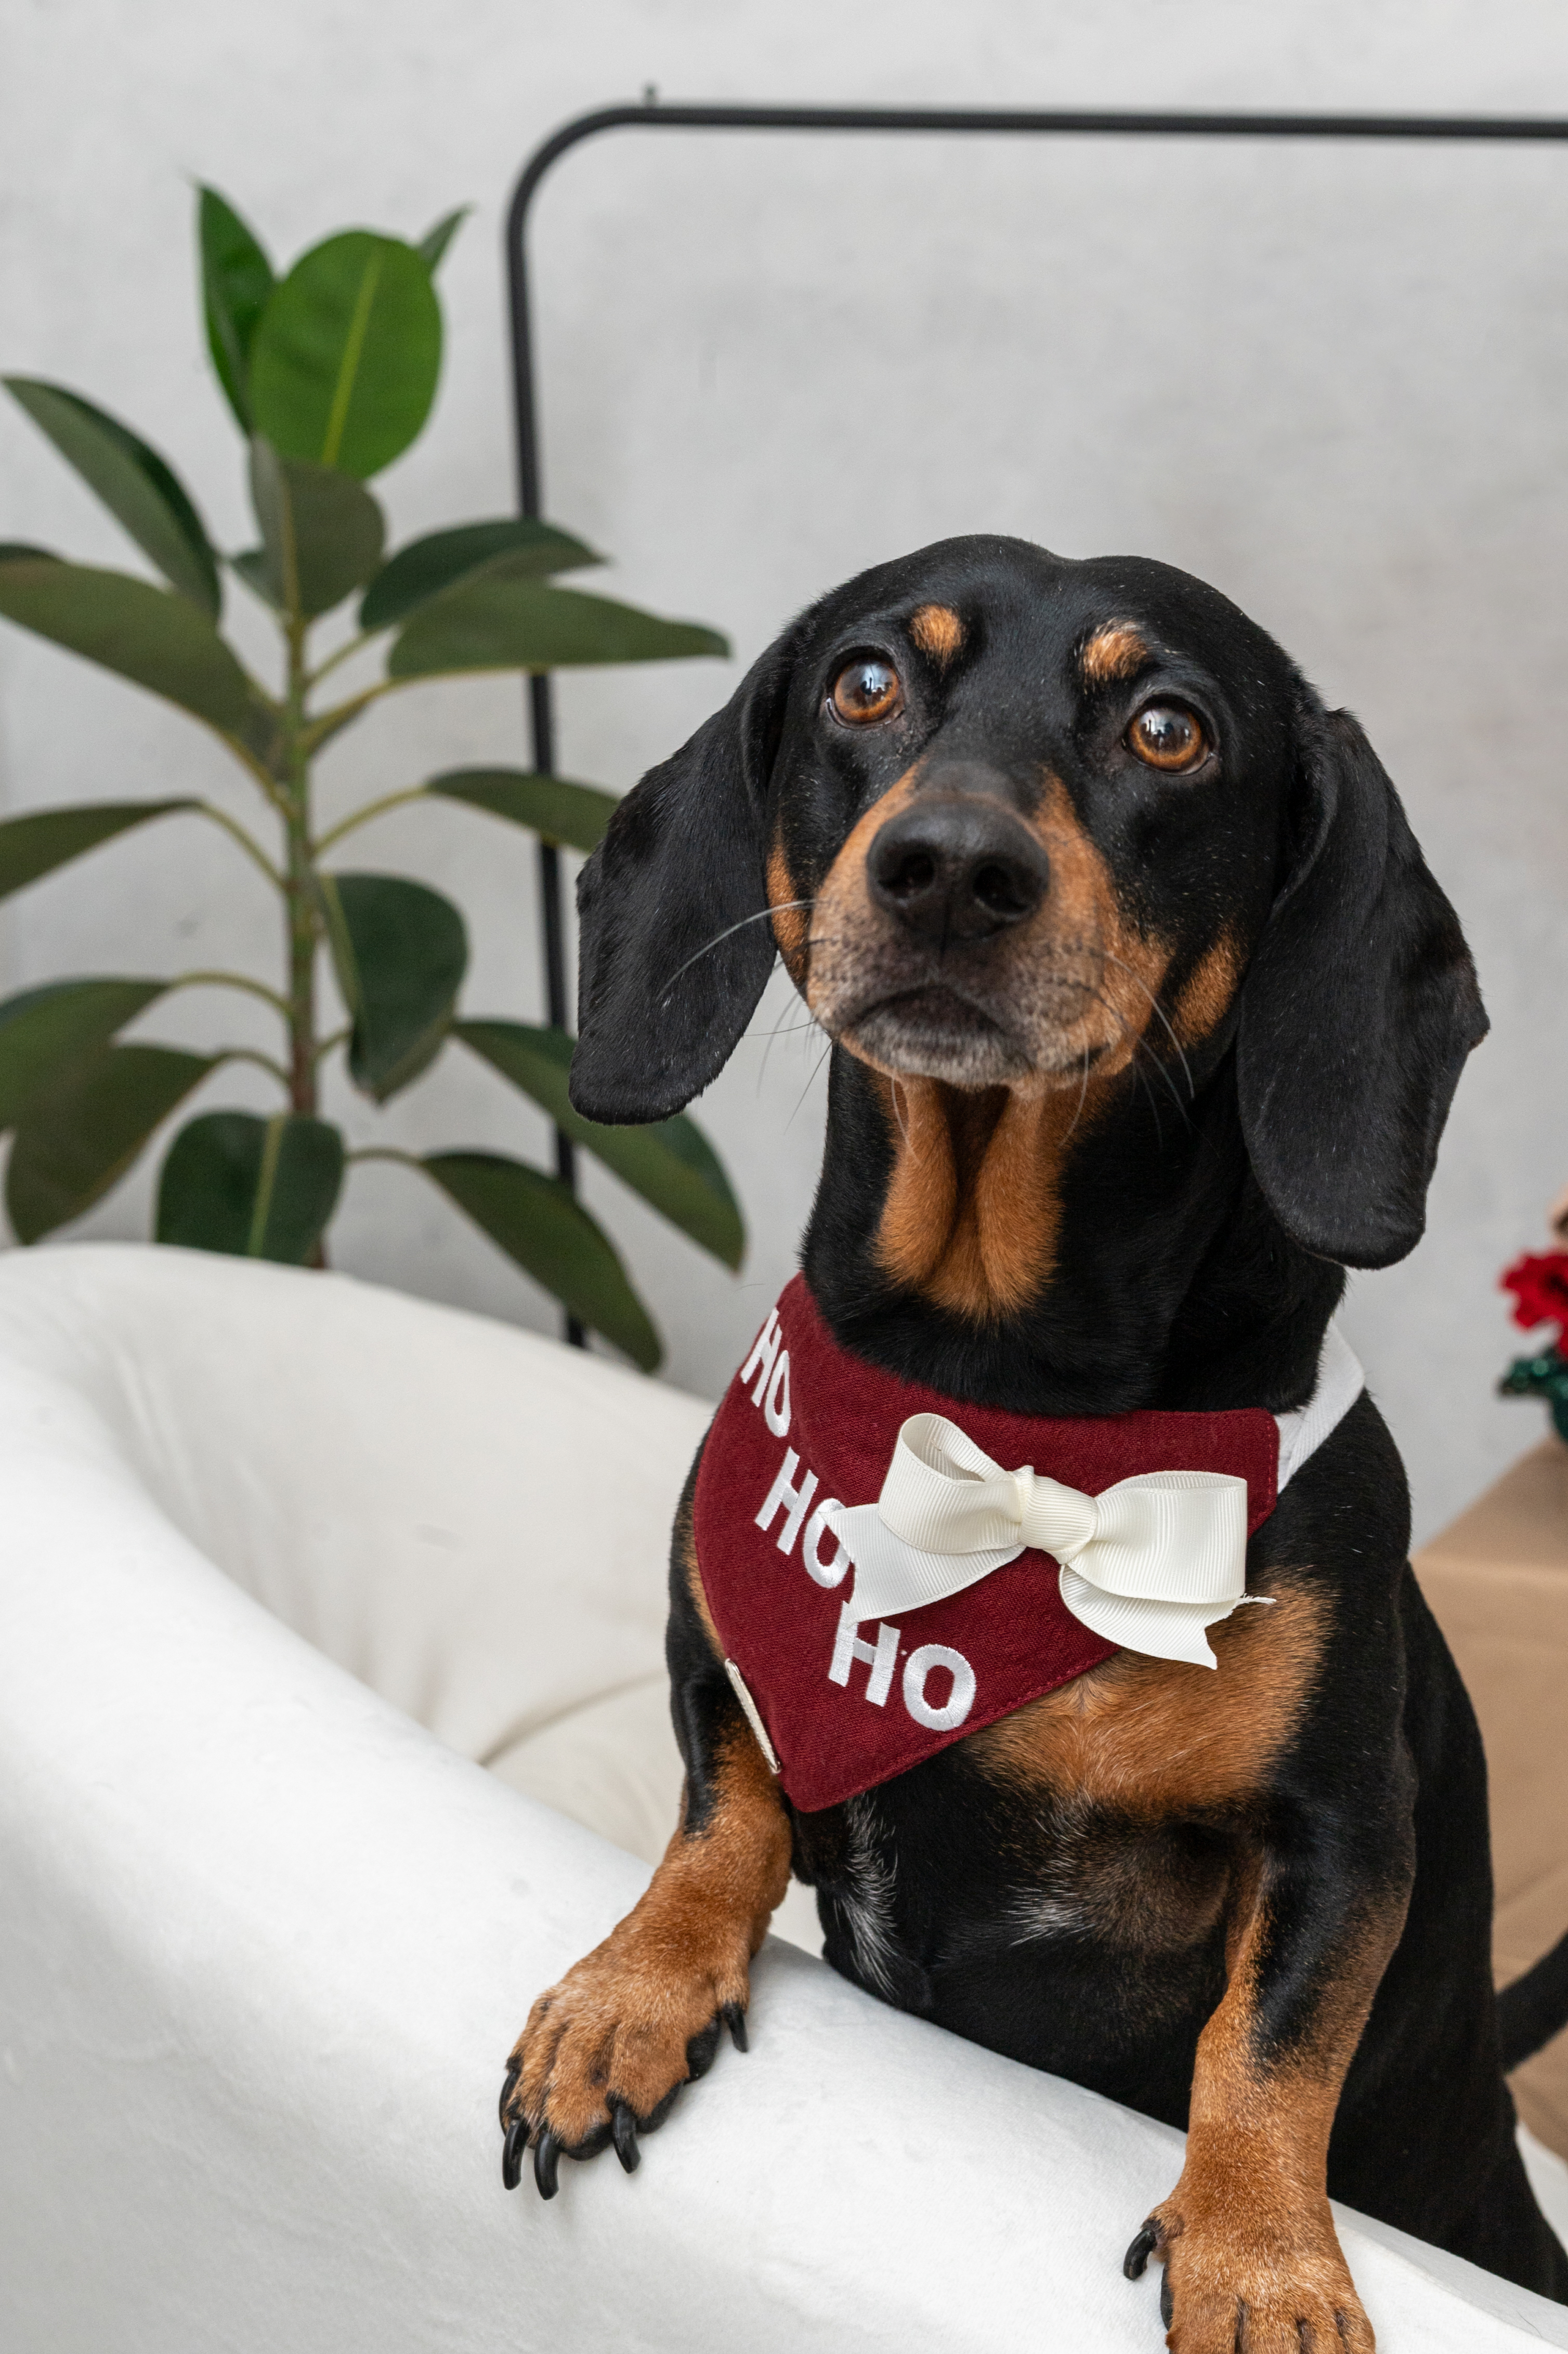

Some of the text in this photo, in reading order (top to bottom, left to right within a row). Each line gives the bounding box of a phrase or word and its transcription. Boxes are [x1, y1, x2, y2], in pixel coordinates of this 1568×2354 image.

[740, 1307, 791, 1437] HO
[754, 1447, 851, 1588] HO
[828, 1600, 976, 1731] HO
